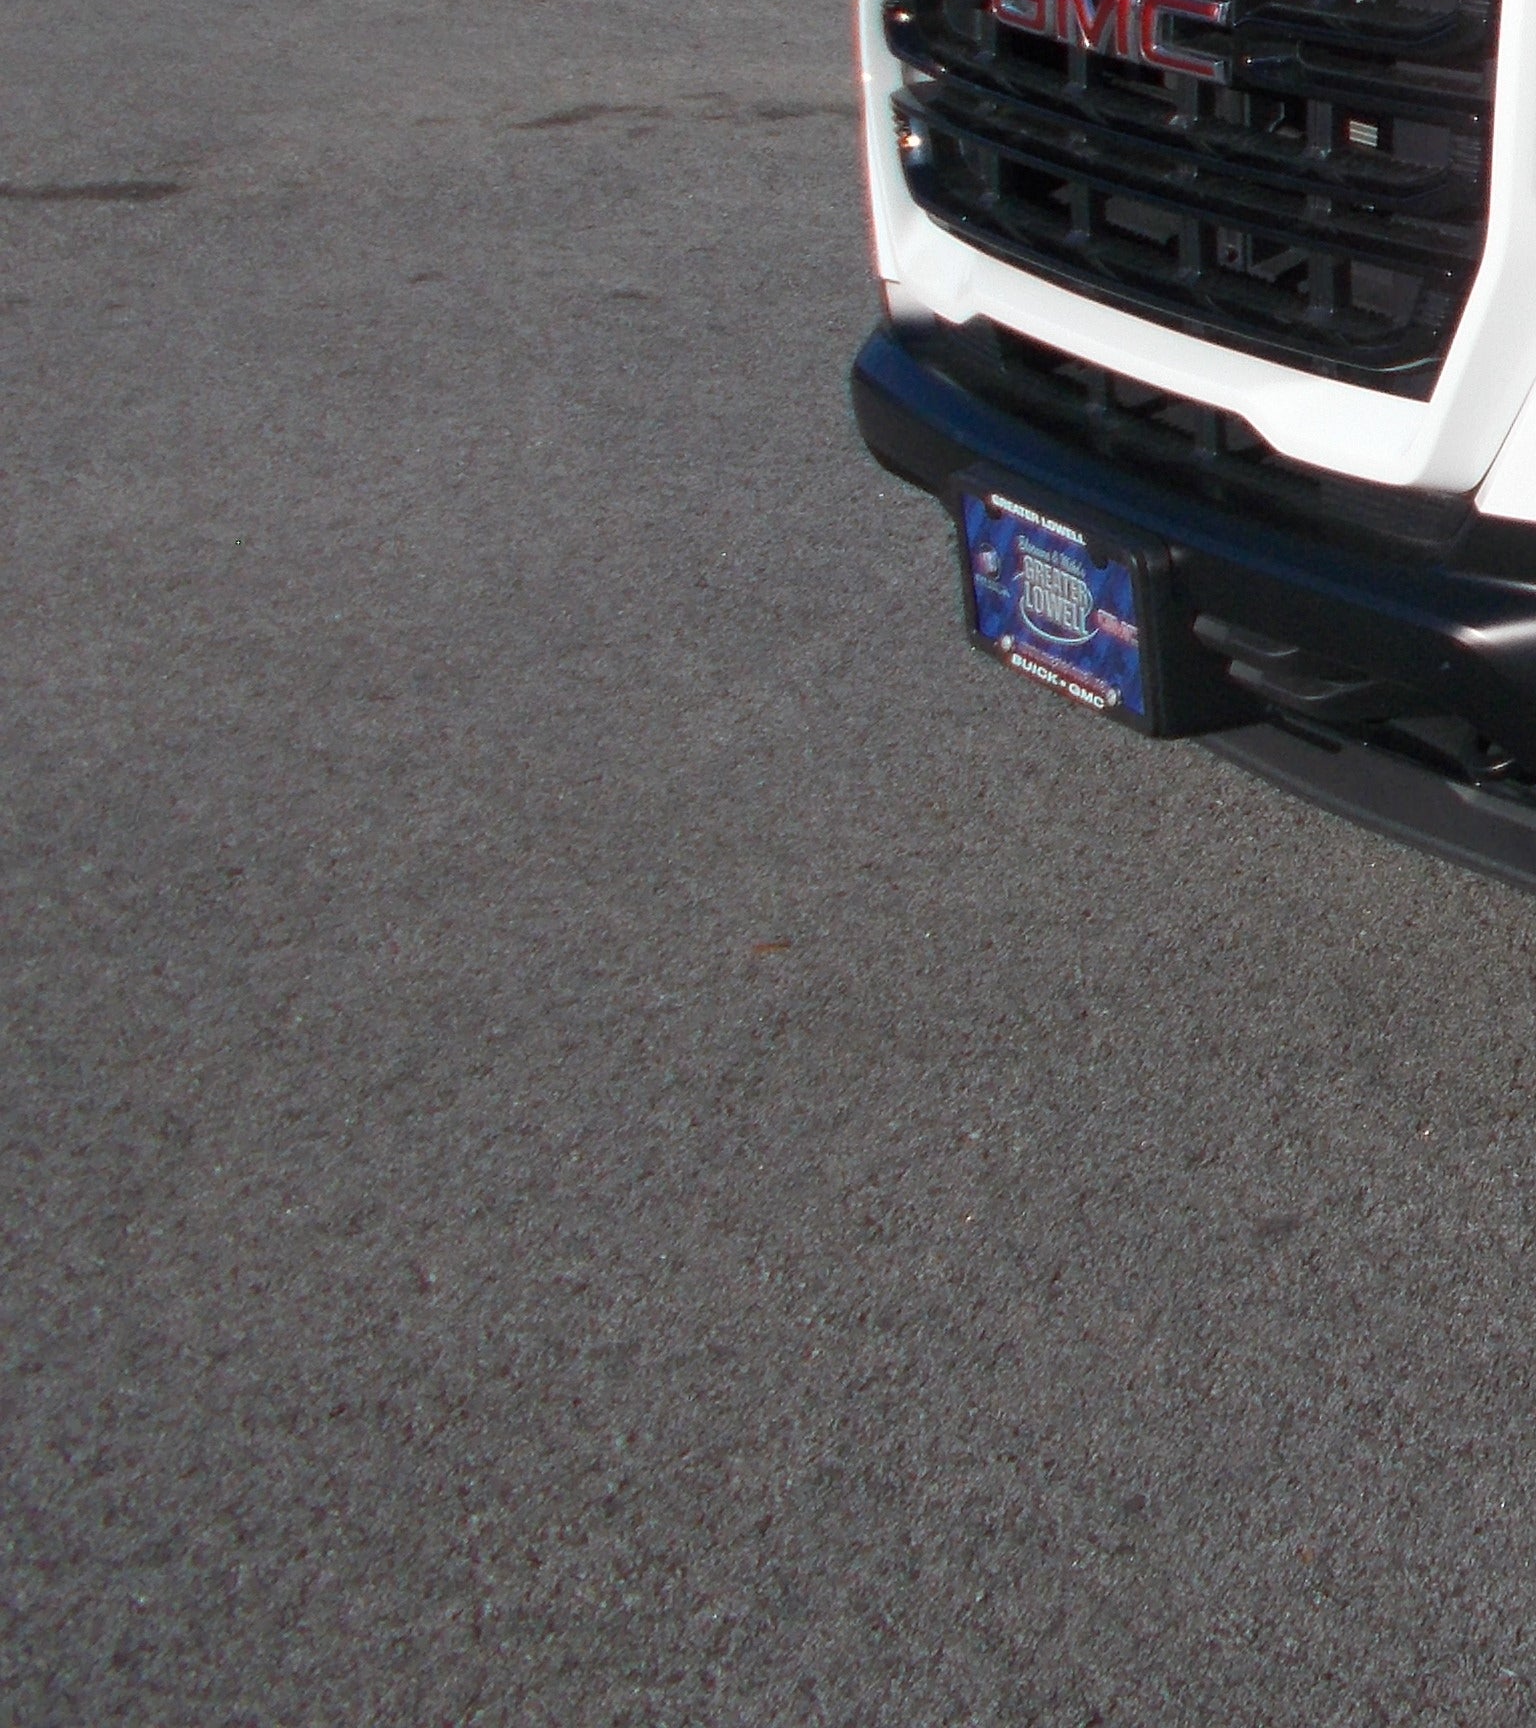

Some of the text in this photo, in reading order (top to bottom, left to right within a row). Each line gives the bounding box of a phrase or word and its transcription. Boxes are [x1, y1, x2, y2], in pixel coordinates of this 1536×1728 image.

[1041, 516, 1087, 546] LOWELL
[1023, 555, 1089, 607] GREATER
[1024, 581, 1089, 635] LOWELL
[1011, 653, 1058, 686] BUICK
[1068, 683, 1105, 709] GMC
